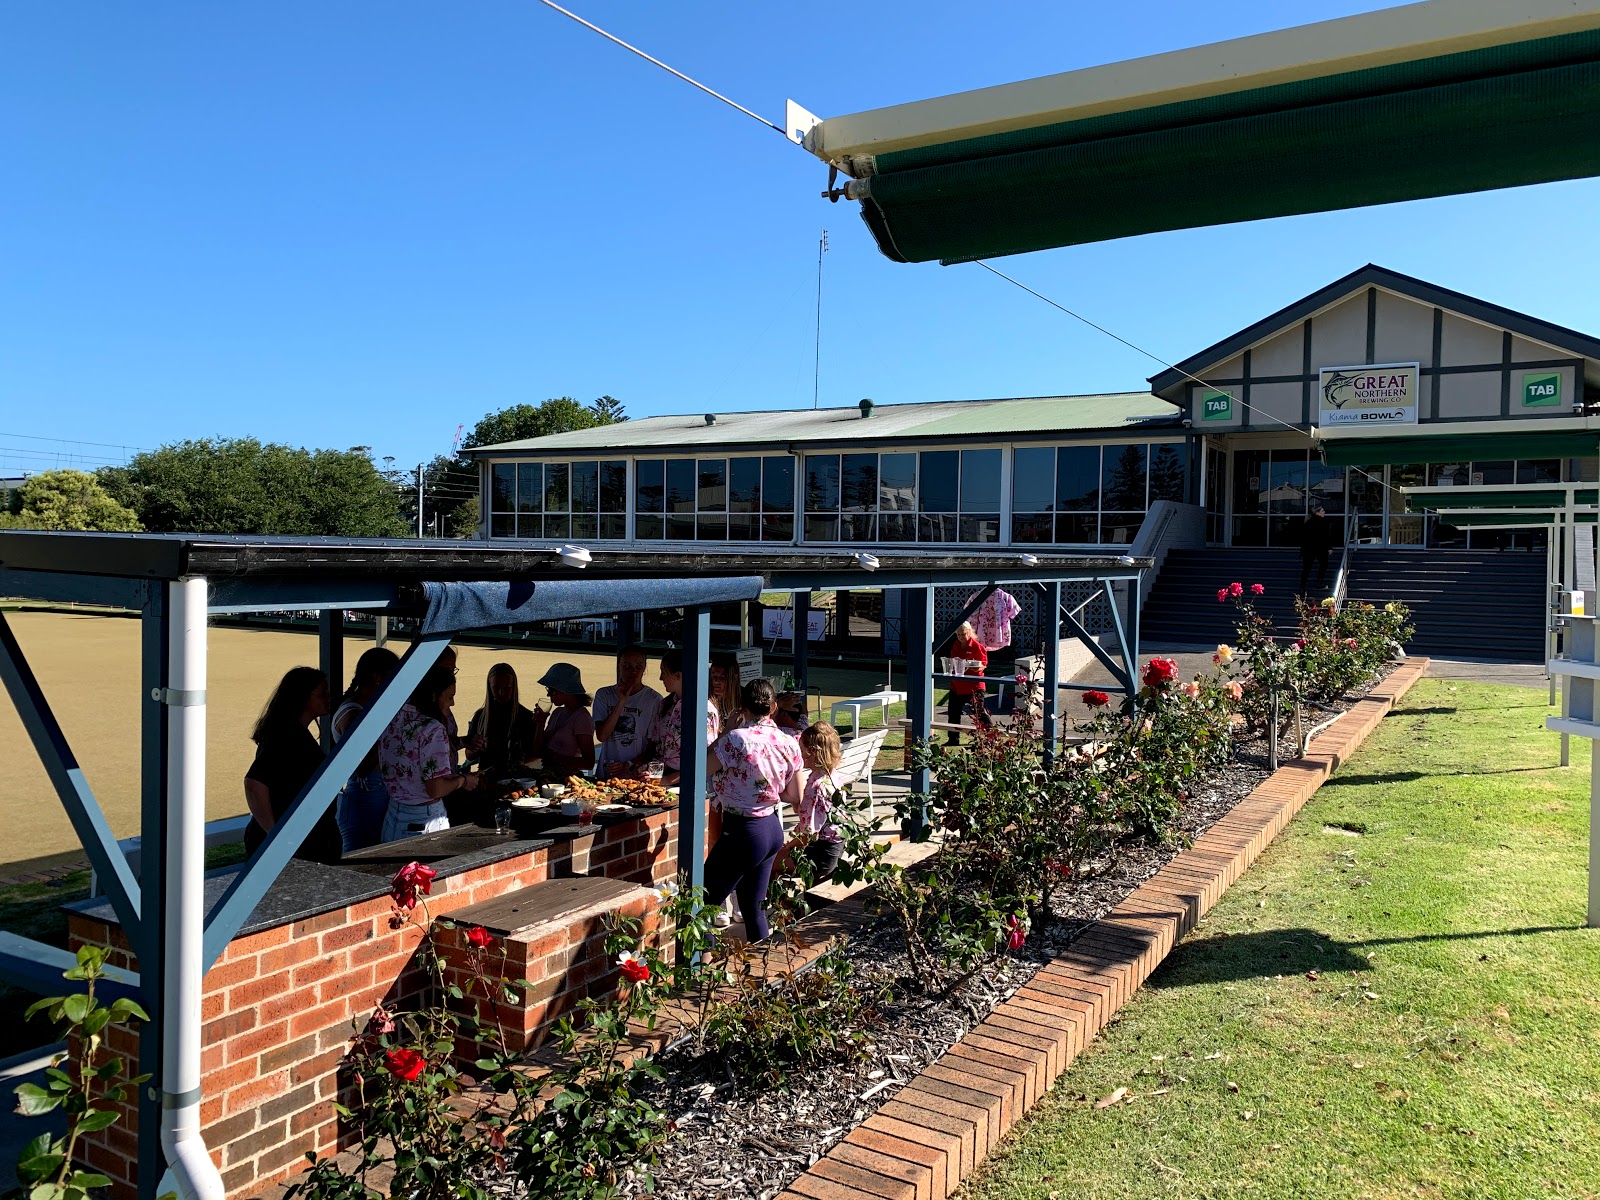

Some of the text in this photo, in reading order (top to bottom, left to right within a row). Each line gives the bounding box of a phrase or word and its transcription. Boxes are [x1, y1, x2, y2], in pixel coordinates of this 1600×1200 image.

[1354, 375, 1408, 389] GREAT
[1355, 388, 1407, 398] NORTHERN
[1528, 385, 1555, 396] TAB
[1207, 401, 1228, 410] TAB
[1329, 413, 1359, 421] Kiama
